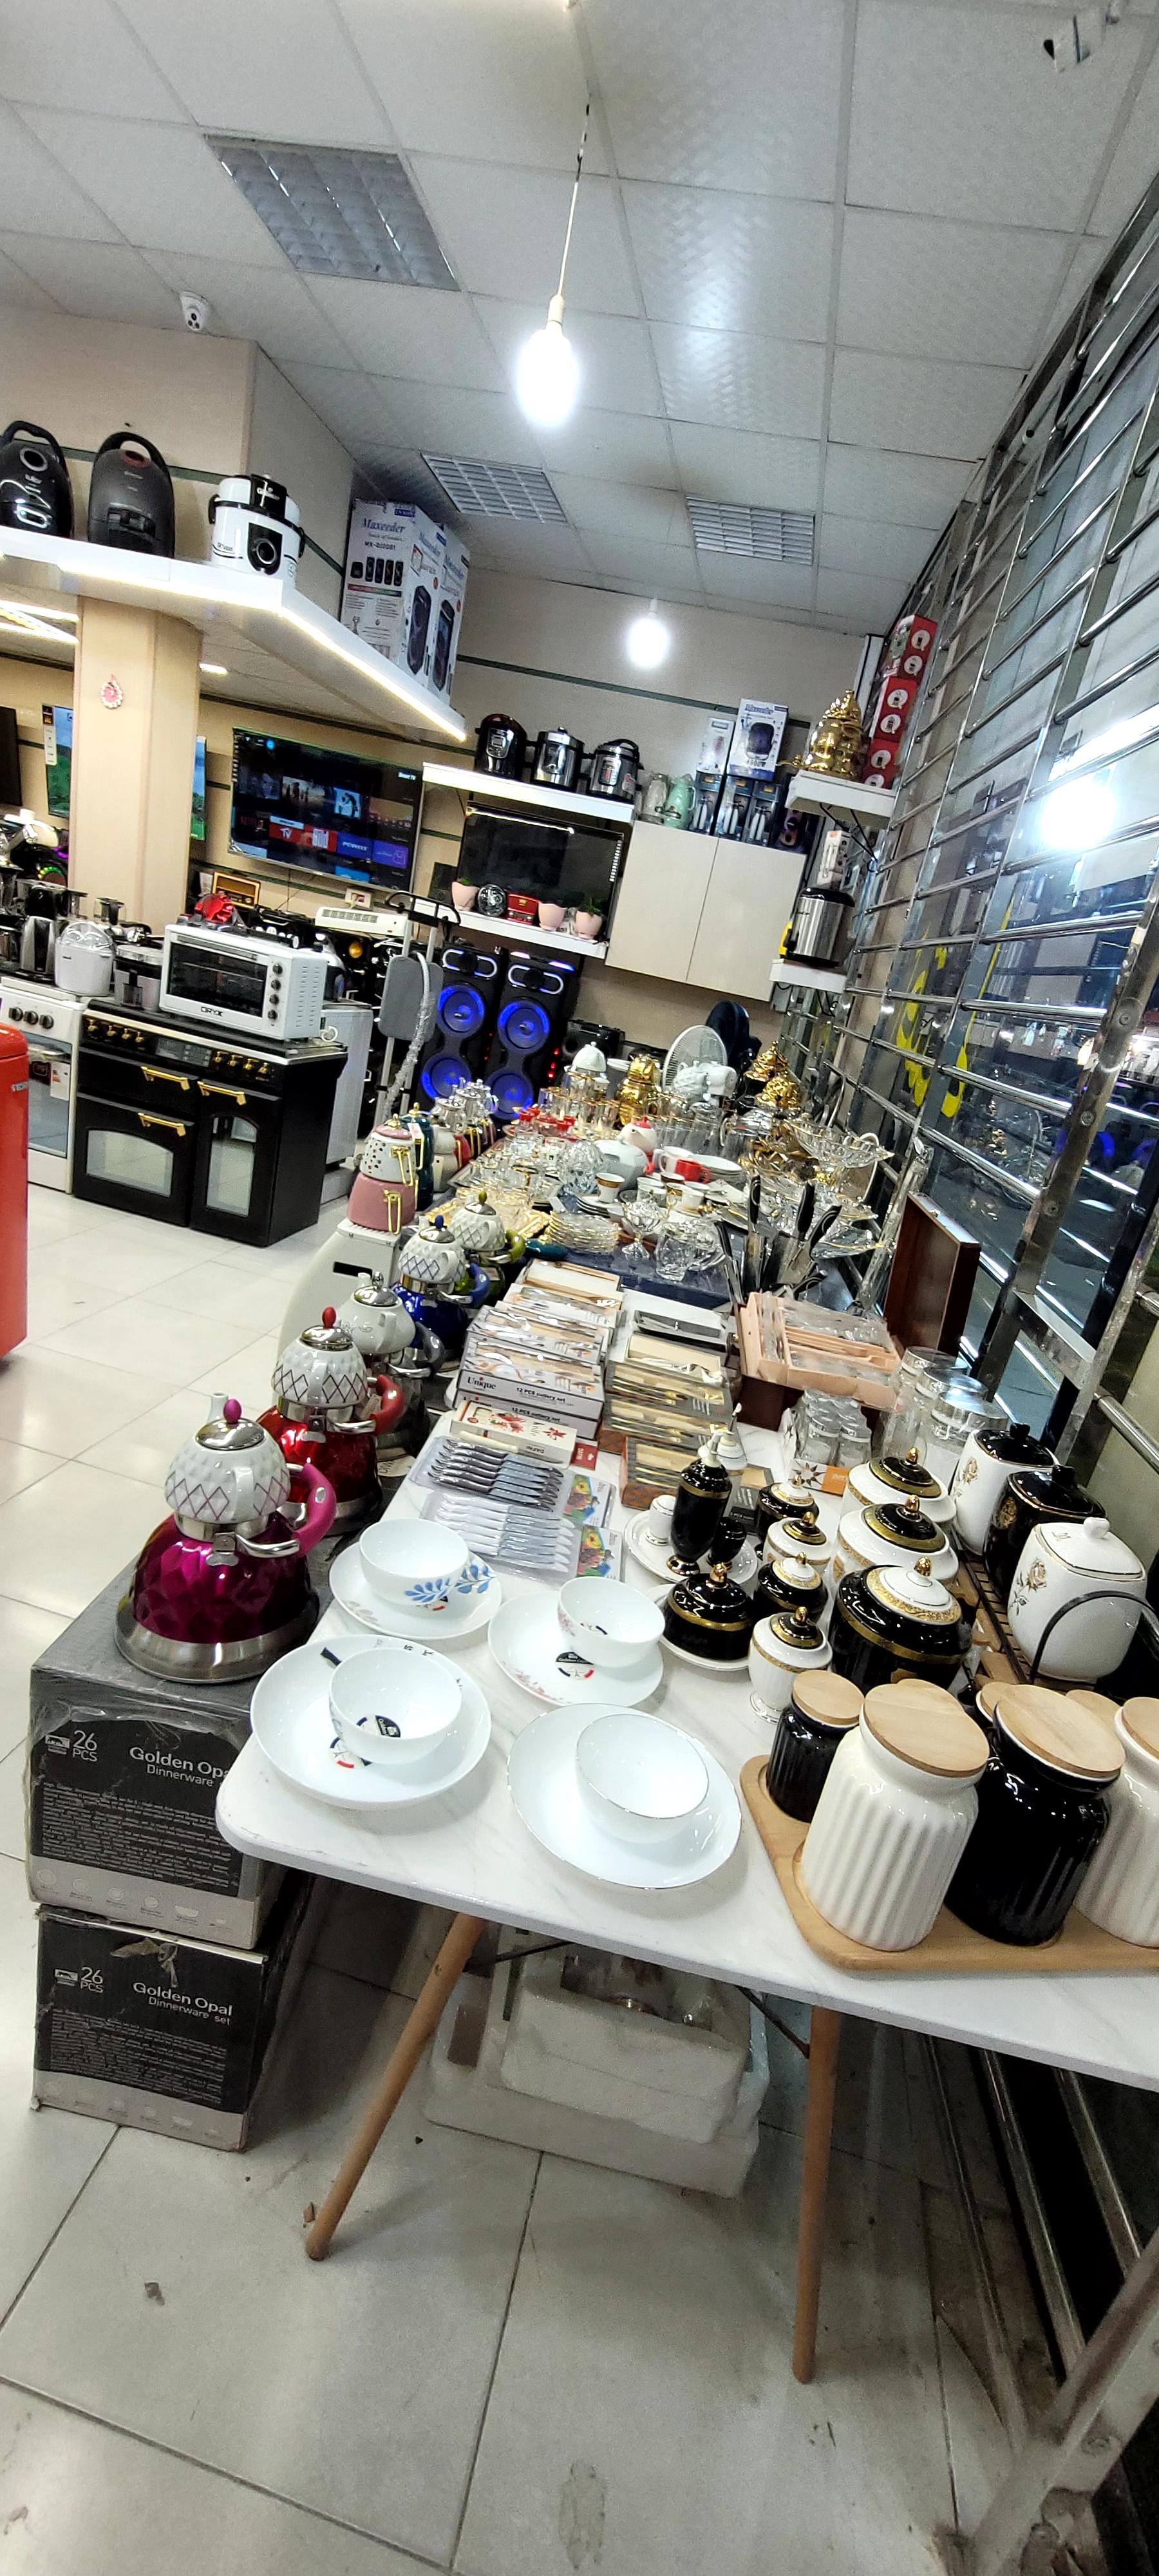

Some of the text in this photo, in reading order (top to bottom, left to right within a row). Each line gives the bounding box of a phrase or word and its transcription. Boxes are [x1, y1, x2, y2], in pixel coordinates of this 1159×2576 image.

[467, 1376, 496, 1390] Unique
[73, 1730, 98, 1752] 26
[72, 1748, 98, 1762] PCS
[129, 1747, 193, 1771] Golden
[146, 1763, 214, 1787] Dinnerware
[80, 1966, 104, 1985] 26
[80, 1981, 104, 1994] PCS
[133, 1982, 233, 2017] Golden Opal
[149, 1996, 231, 2026] Dinnerware set
